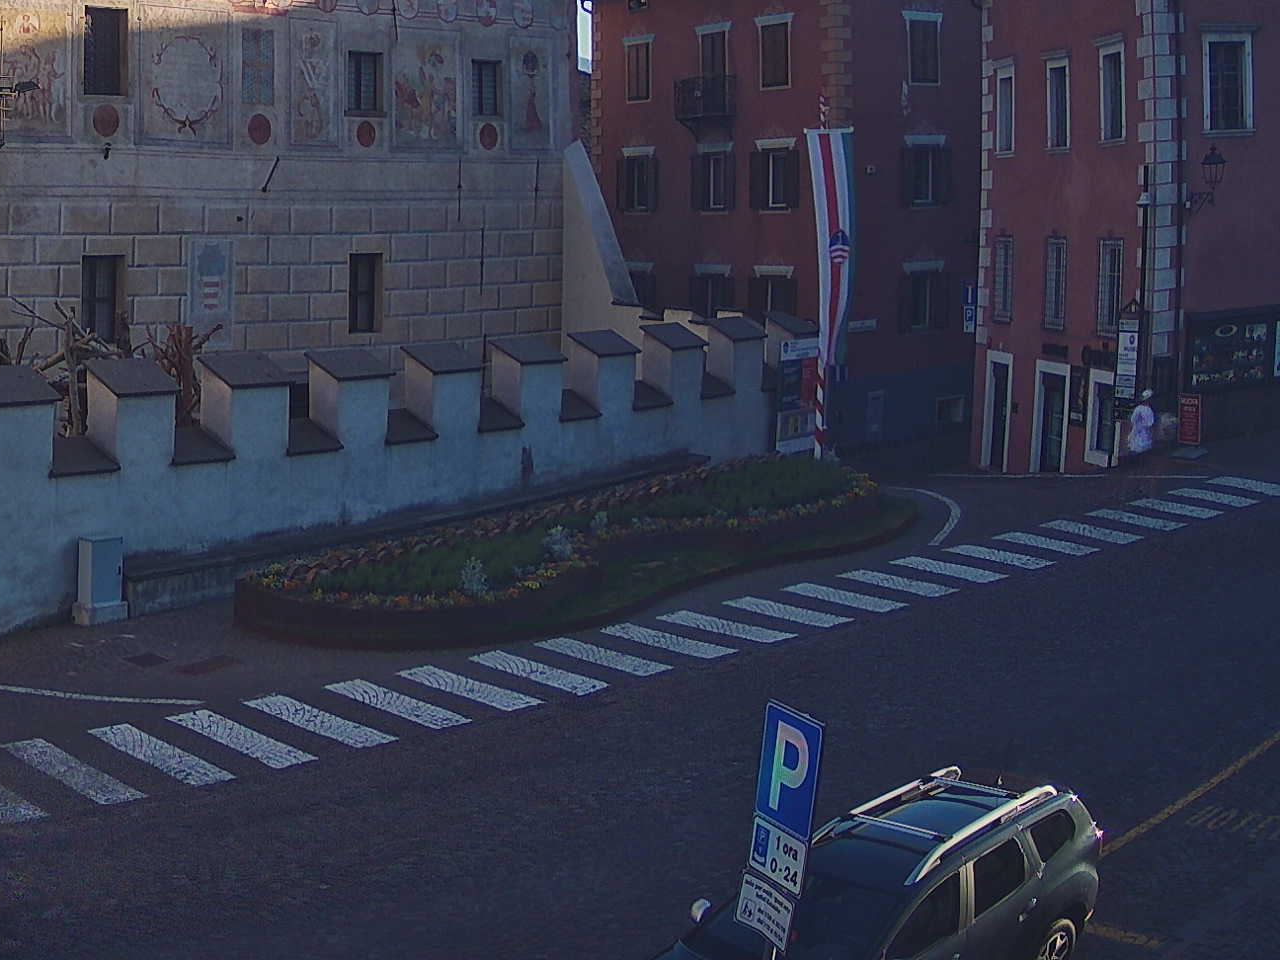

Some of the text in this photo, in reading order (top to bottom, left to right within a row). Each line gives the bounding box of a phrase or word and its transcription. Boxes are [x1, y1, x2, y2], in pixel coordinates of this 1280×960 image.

[966, 309, 972, 321] P
[769, 720, 809, 811] P
[776, 836, 798, 861] 1 ora
